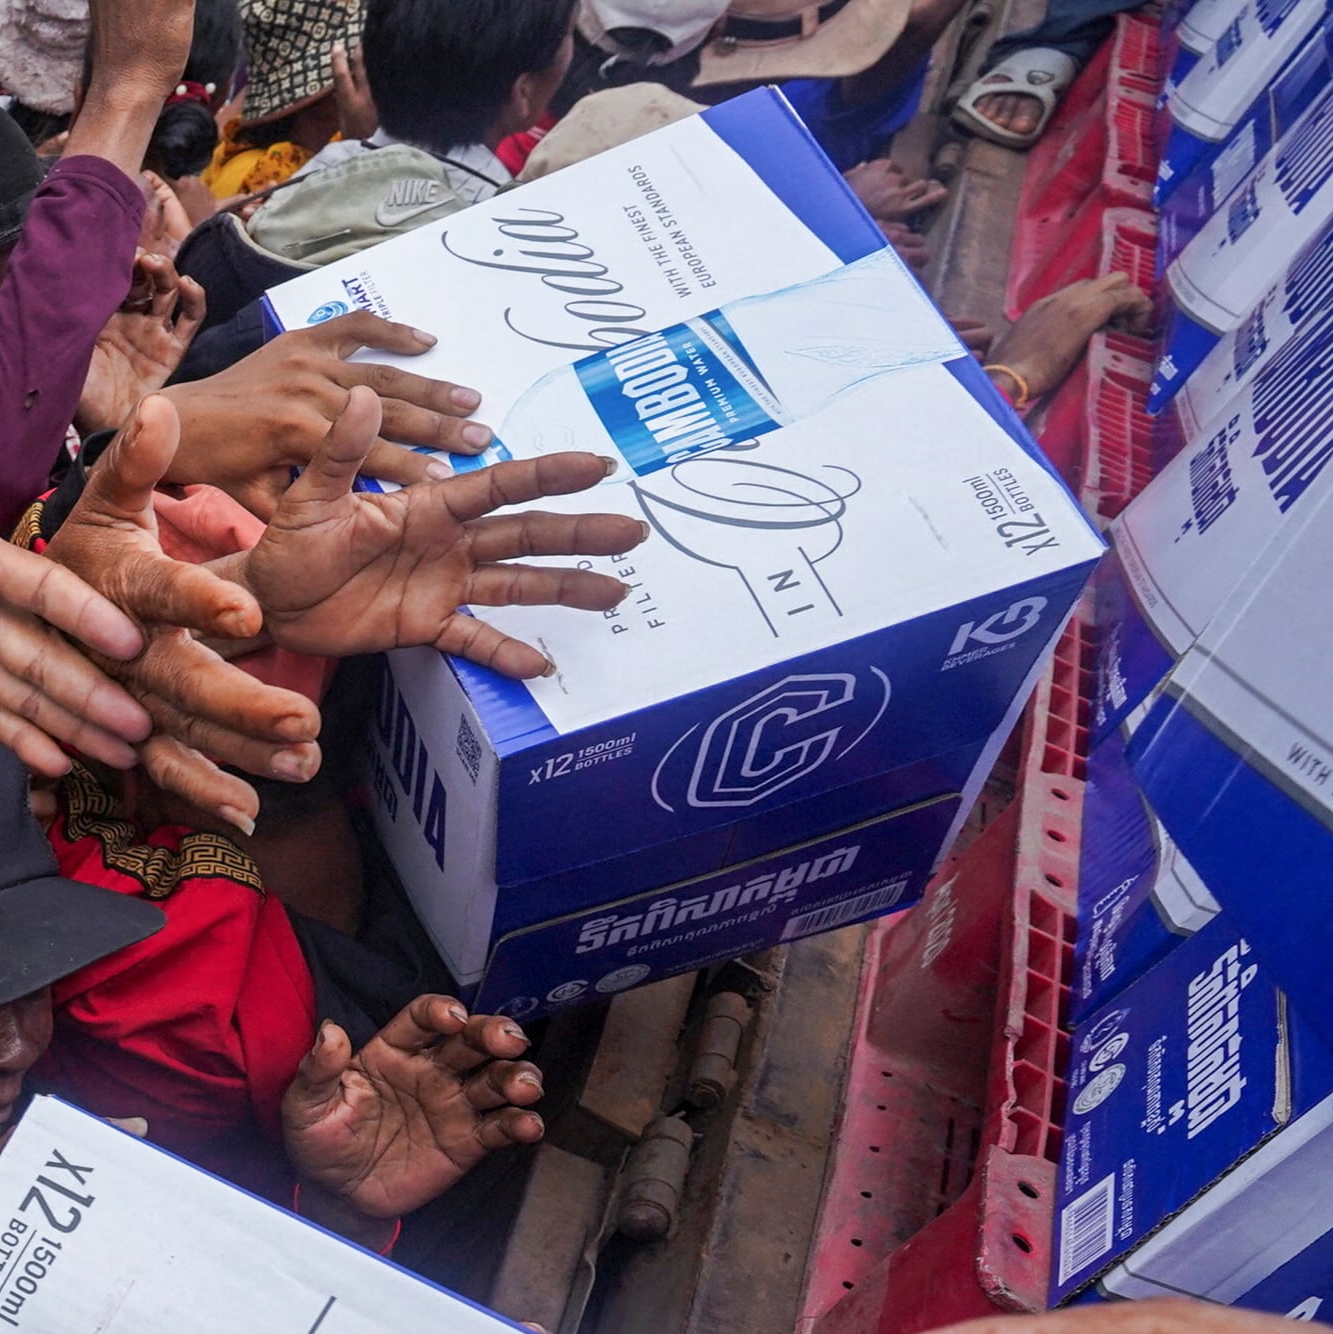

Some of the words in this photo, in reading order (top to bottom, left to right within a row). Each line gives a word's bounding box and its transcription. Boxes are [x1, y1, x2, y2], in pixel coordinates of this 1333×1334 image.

[386, 177, 439, 207] NIKE
[627, 164, 678, 229] STANDARDS
[622, 204, 657, 243] FINEST
[648, 244, 671, 267] THE
[669, 230, 717, 289] EUROPEAN
[341, 277, 378, 317] ART
[663, 268, 692, 299] WITH
[683, 341, 709, 375] WATER
[605, 331, 735, 465] CAMBODIA
[704, 378, 742, 424] PREMIUM
[962, 474, 1009, 521] 1500ml
[993, 466, 1036, 513] BOTTLES
[610, 553, 666, 630] FILTER
[767, 568, 815, 617] IN
[940, 641, 1017, 672] BEVERAGES
[942, 646, 989, 666] KHMER
[575, 746, 633, 772] BOTTLES
[577, 732, 637, 759] 1500ml
[1287, 742, 1333, 787] WITH
